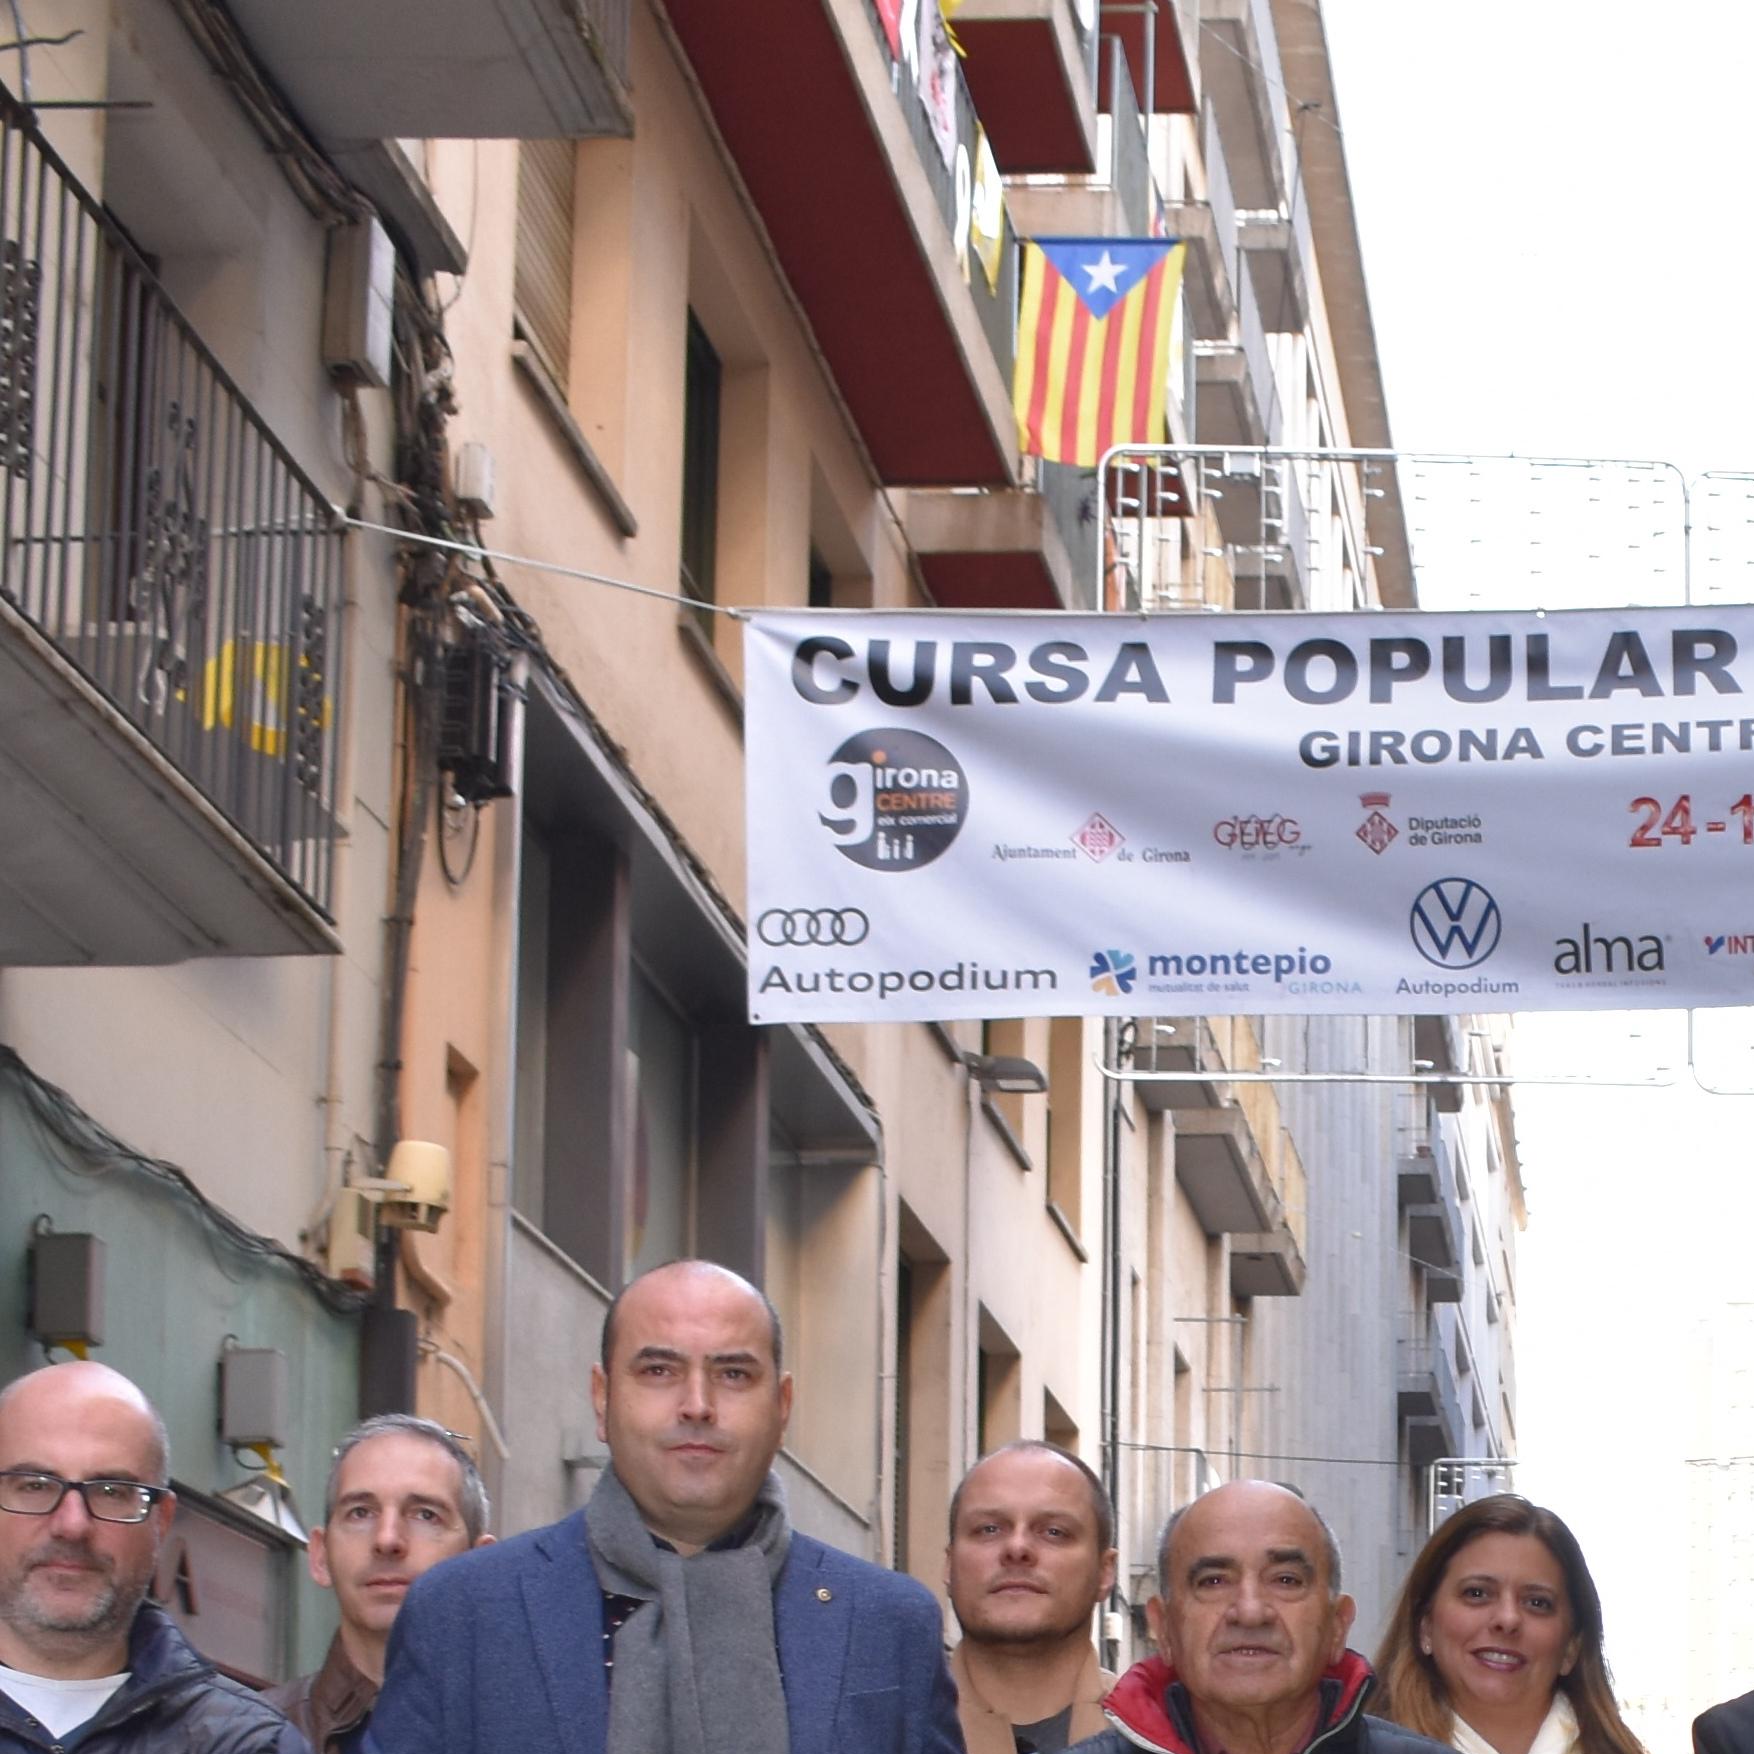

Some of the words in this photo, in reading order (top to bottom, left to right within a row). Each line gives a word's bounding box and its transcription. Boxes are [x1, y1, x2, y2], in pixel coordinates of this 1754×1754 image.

[791, 635, 1171, 707] CURSA
[1212, 629, 1743, 705] POPULAR
[1300, 727, 1544, 769] GIRONA
[876, 793, 957, 811] CENTRE
[1408, 813, 1482, 833] Diputació
[1409, 832, 1427, 846] de
[1430, 831, 1482, 847] Girona
[992, 844, 1077, 861] Ajuntament
[1117, 847, 1133, 862] de
[1142, 846, 1191, 864] Girona
[1554, 922, 1665, 975] alma
[1149, 946, 1332, 982] montepio
[759, 961, 1057, 999] Autopodium
[1288, 981, 1363, 994] GIRONA
[1395, 977, 1520, 998] Autopodium
